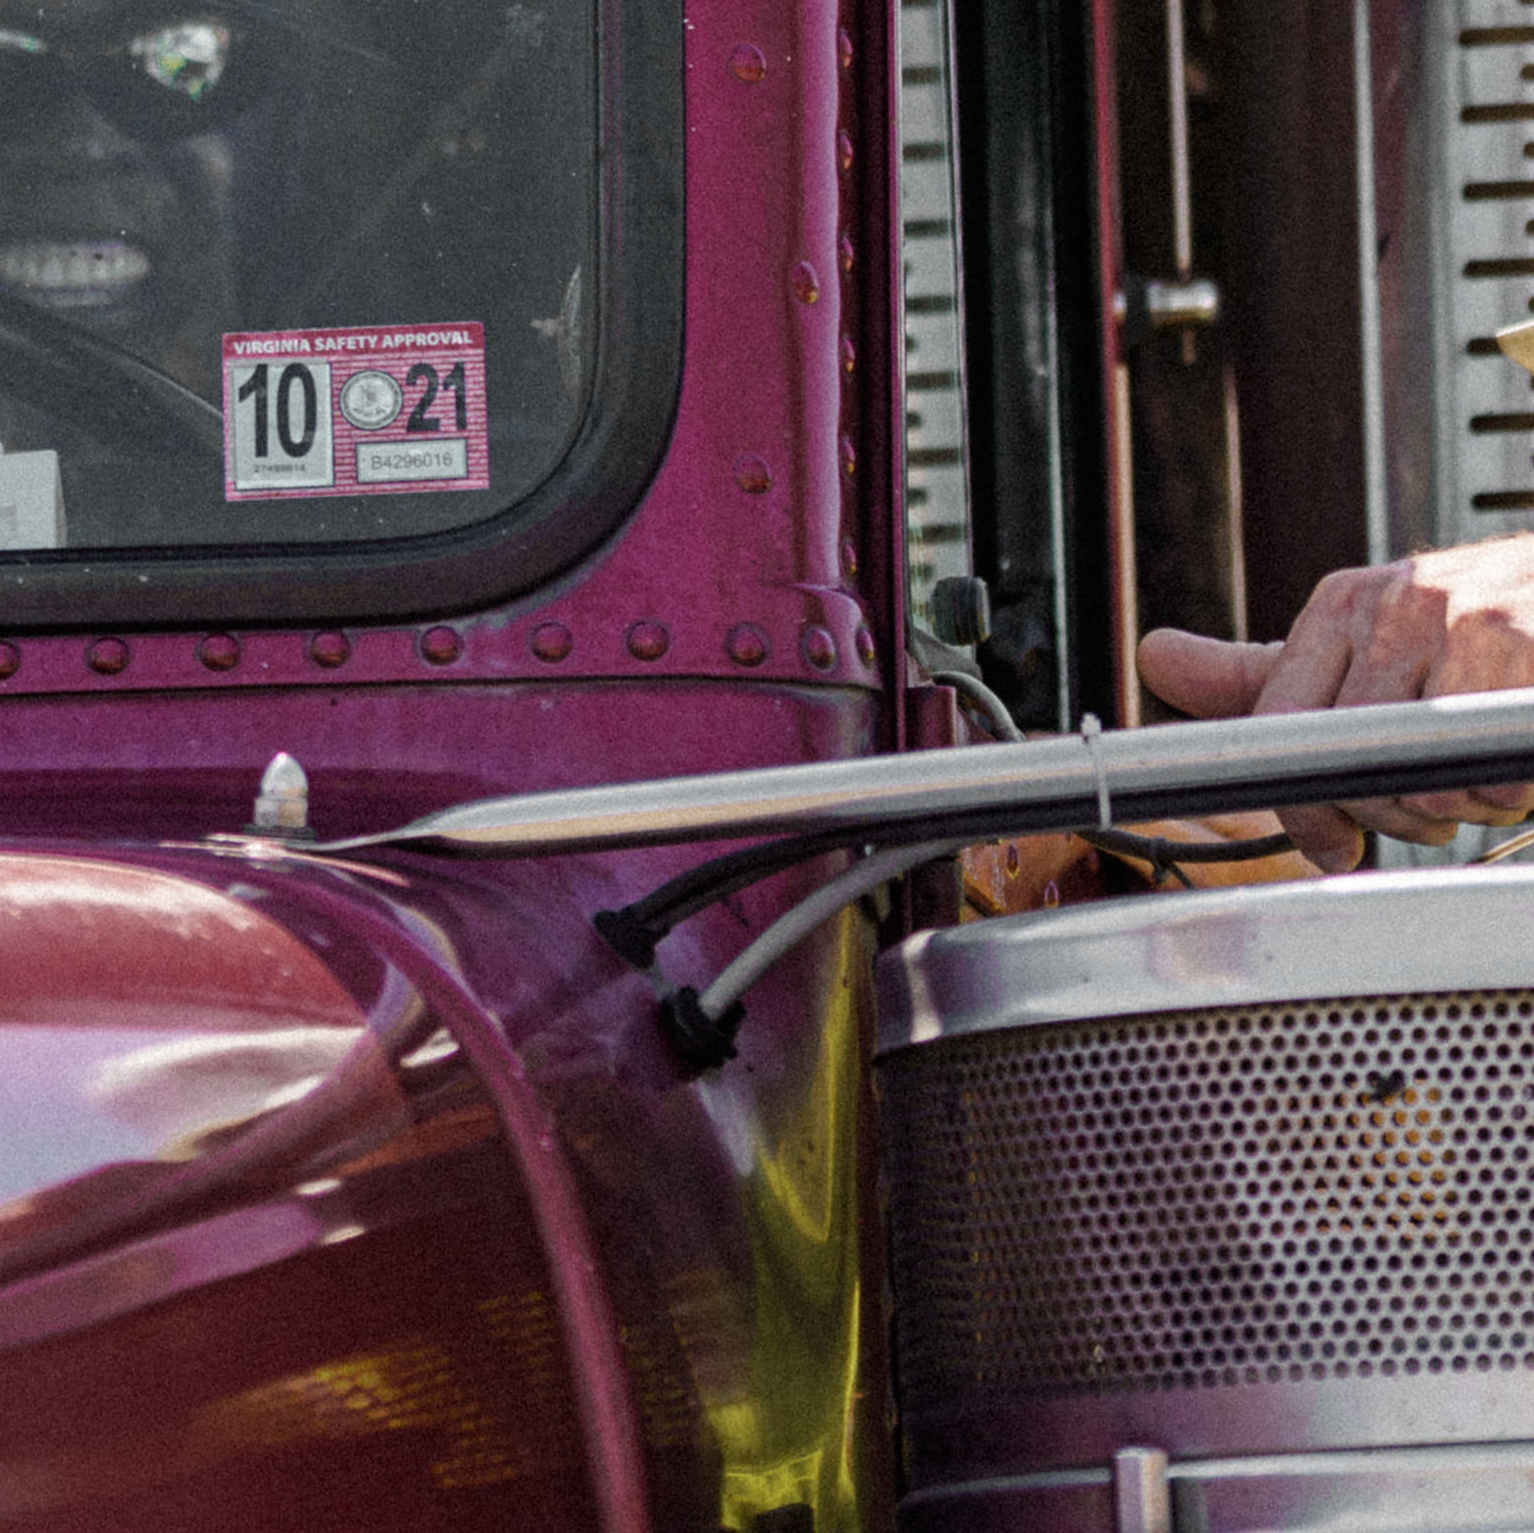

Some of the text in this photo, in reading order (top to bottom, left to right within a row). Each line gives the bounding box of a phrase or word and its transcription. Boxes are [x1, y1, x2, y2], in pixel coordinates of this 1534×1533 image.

[233, 331, 473, 354] VIRGINIA SAFETY APPROVAL
[238, 362, 317, 459] 10
[405, 360, 467, 433] 21
